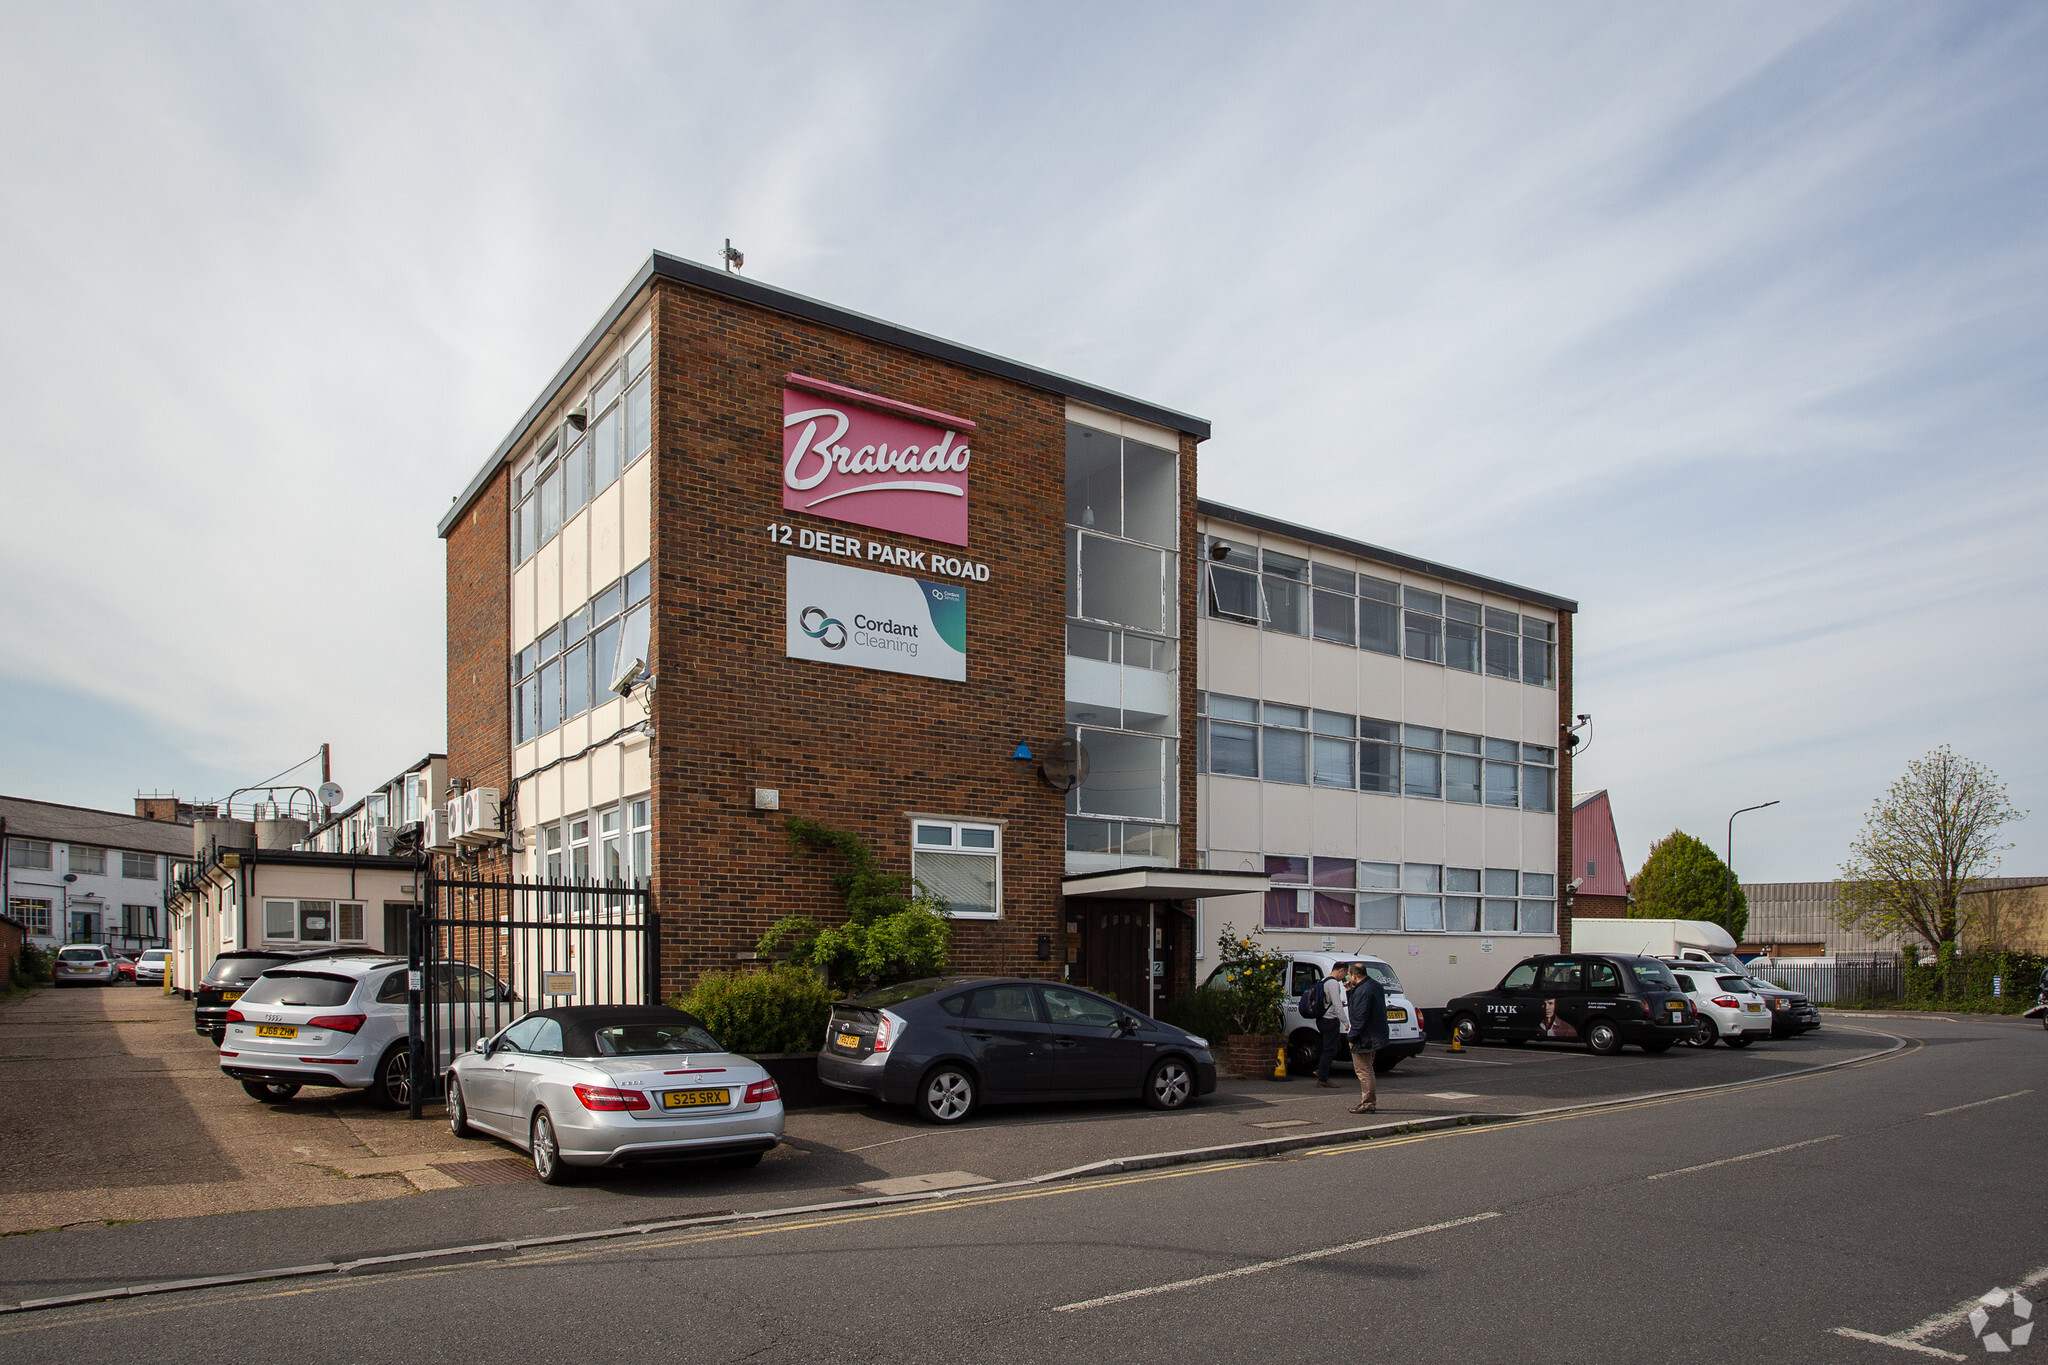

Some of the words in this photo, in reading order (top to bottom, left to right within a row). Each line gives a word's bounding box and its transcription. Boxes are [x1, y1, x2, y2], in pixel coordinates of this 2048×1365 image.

[784, 408, 971, 491] Bravado
[766, 523, 793, 546] 12
[799, 528, 862, 559] DEER
[867, 541, 926, 571] PARK
[931, 554, 990, 582] ROAD
[854, 614, 919, 638] Cordant
[854, 631, 919, 657] Cleaning
[1487, 1005, 1518, 1014] PINK
[279, 1027, 296, 1037] ZHM
[673, 1093, 697, 1106] S25
[698, 1091, 722, 1104] SRX
